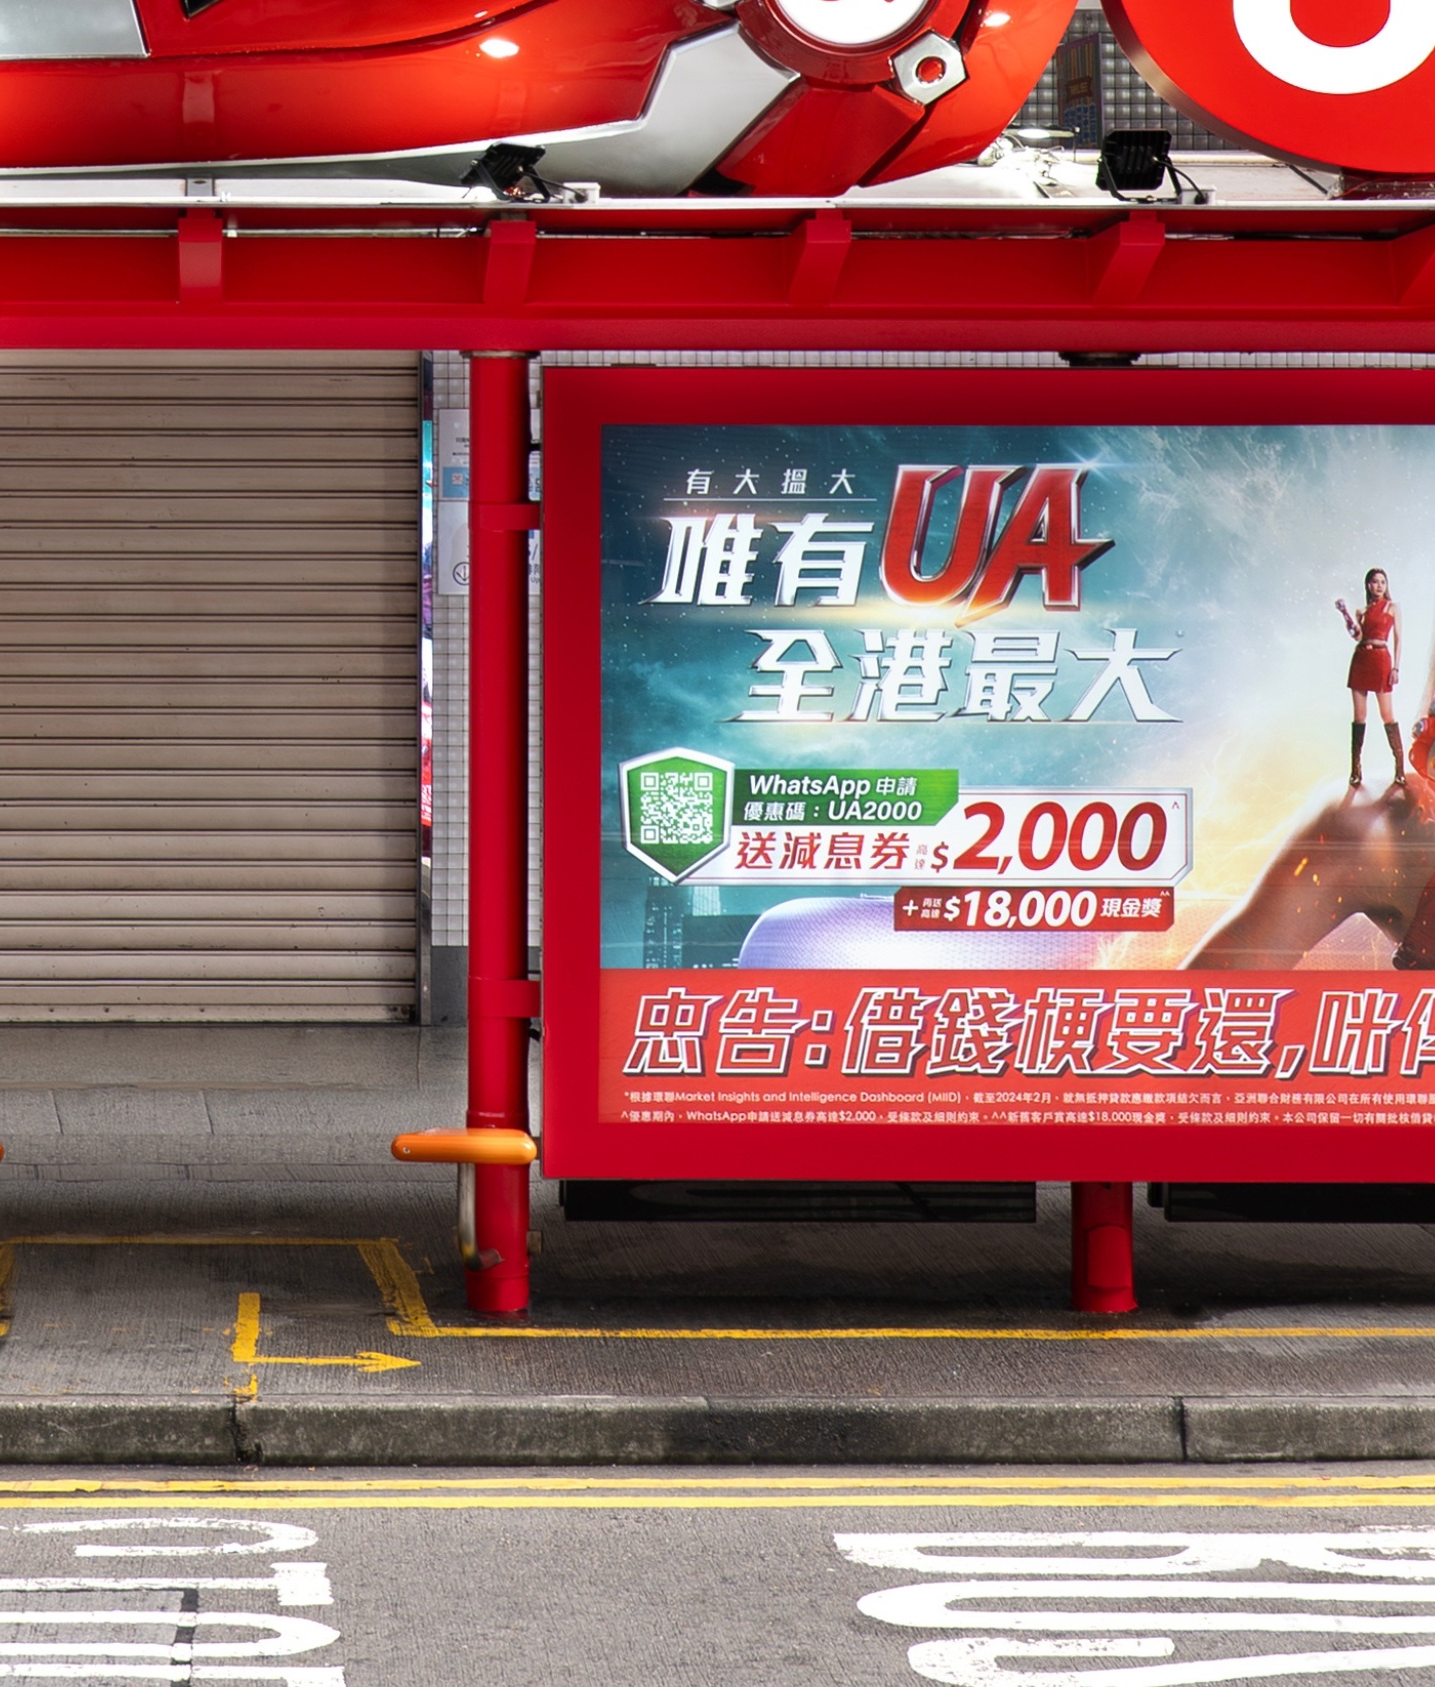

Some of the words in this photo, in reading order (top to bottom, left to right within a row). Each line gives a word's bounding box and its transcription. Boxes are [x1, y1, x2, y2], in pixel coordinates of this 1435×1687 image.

[748, 773, 871, 798] WhatsApp
[876, 776, 918, 798] 申請
[944, 890, 1096, 928] $18,000
[717, 1091, 760, 1104] Insights
[762, 1092, 786, 1103] and
[789, 1091, 857, 1104] Intelligence
[860, 1091, 924, 1103] Dashboard
